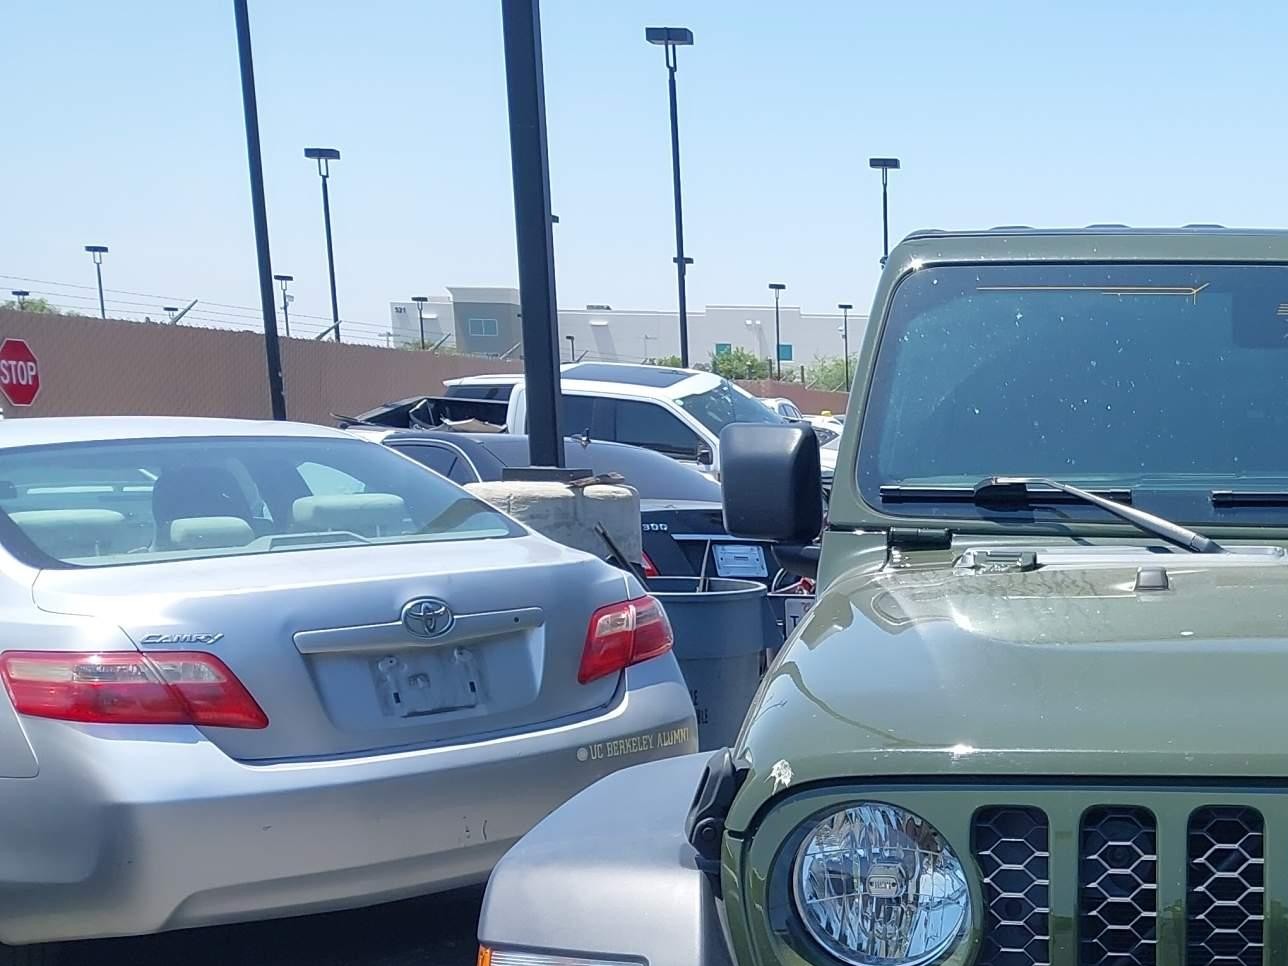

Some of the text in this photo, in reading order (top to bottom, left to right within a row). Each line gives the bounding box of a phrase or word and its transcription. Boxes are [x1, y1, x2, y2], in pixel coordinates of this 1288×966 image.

[0, 359, 37, 385] STOP
[140, 632, 224, 645] CAMRY
[590, 727, 689, 759] UC BERKELEY ALUMNI
